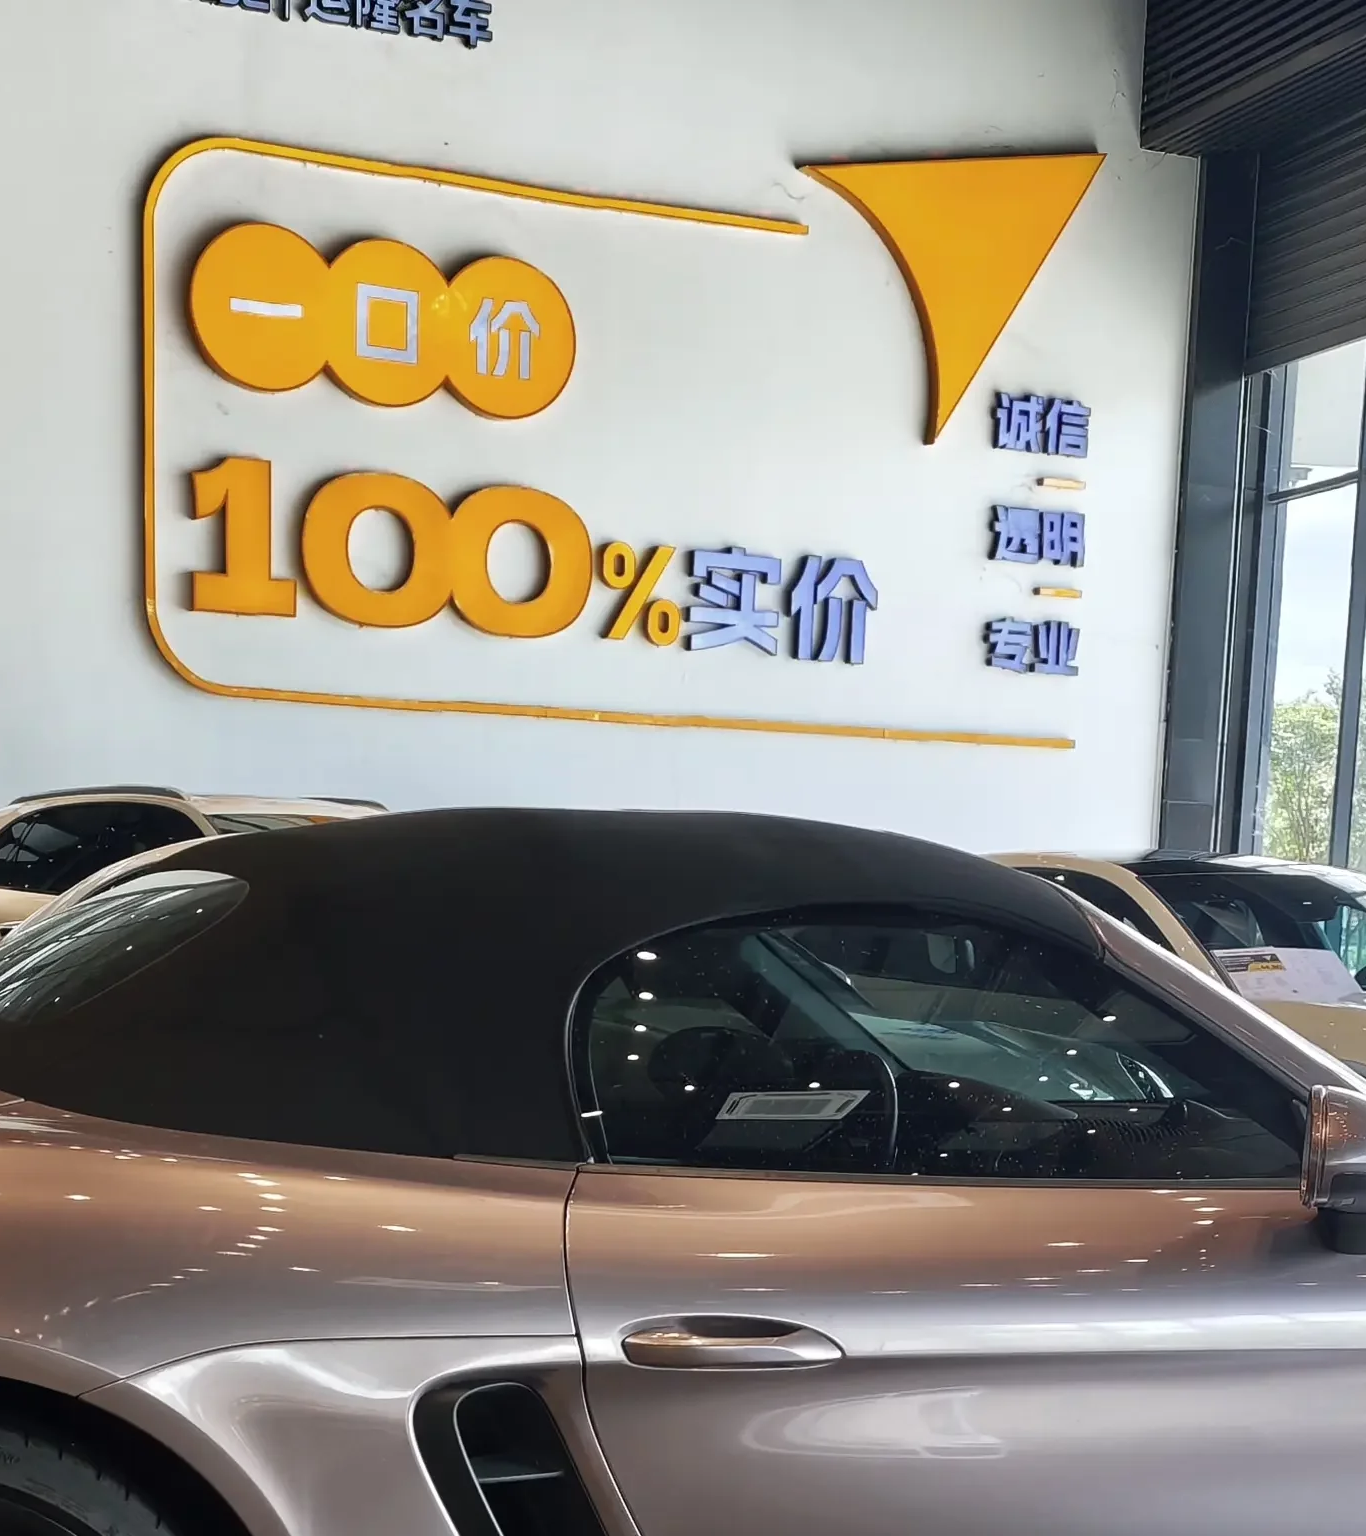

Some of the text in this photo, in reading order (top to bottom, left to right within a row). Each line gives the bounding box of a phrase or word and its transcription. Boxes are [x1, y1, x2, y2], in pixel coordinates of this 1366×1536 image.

[229, 283, 541, 381] 一口价
[990, 391, 1090, 459] 诚信
[988, 504, 1086, 568] 透明
[983, 617, 1081, 676] 专业
